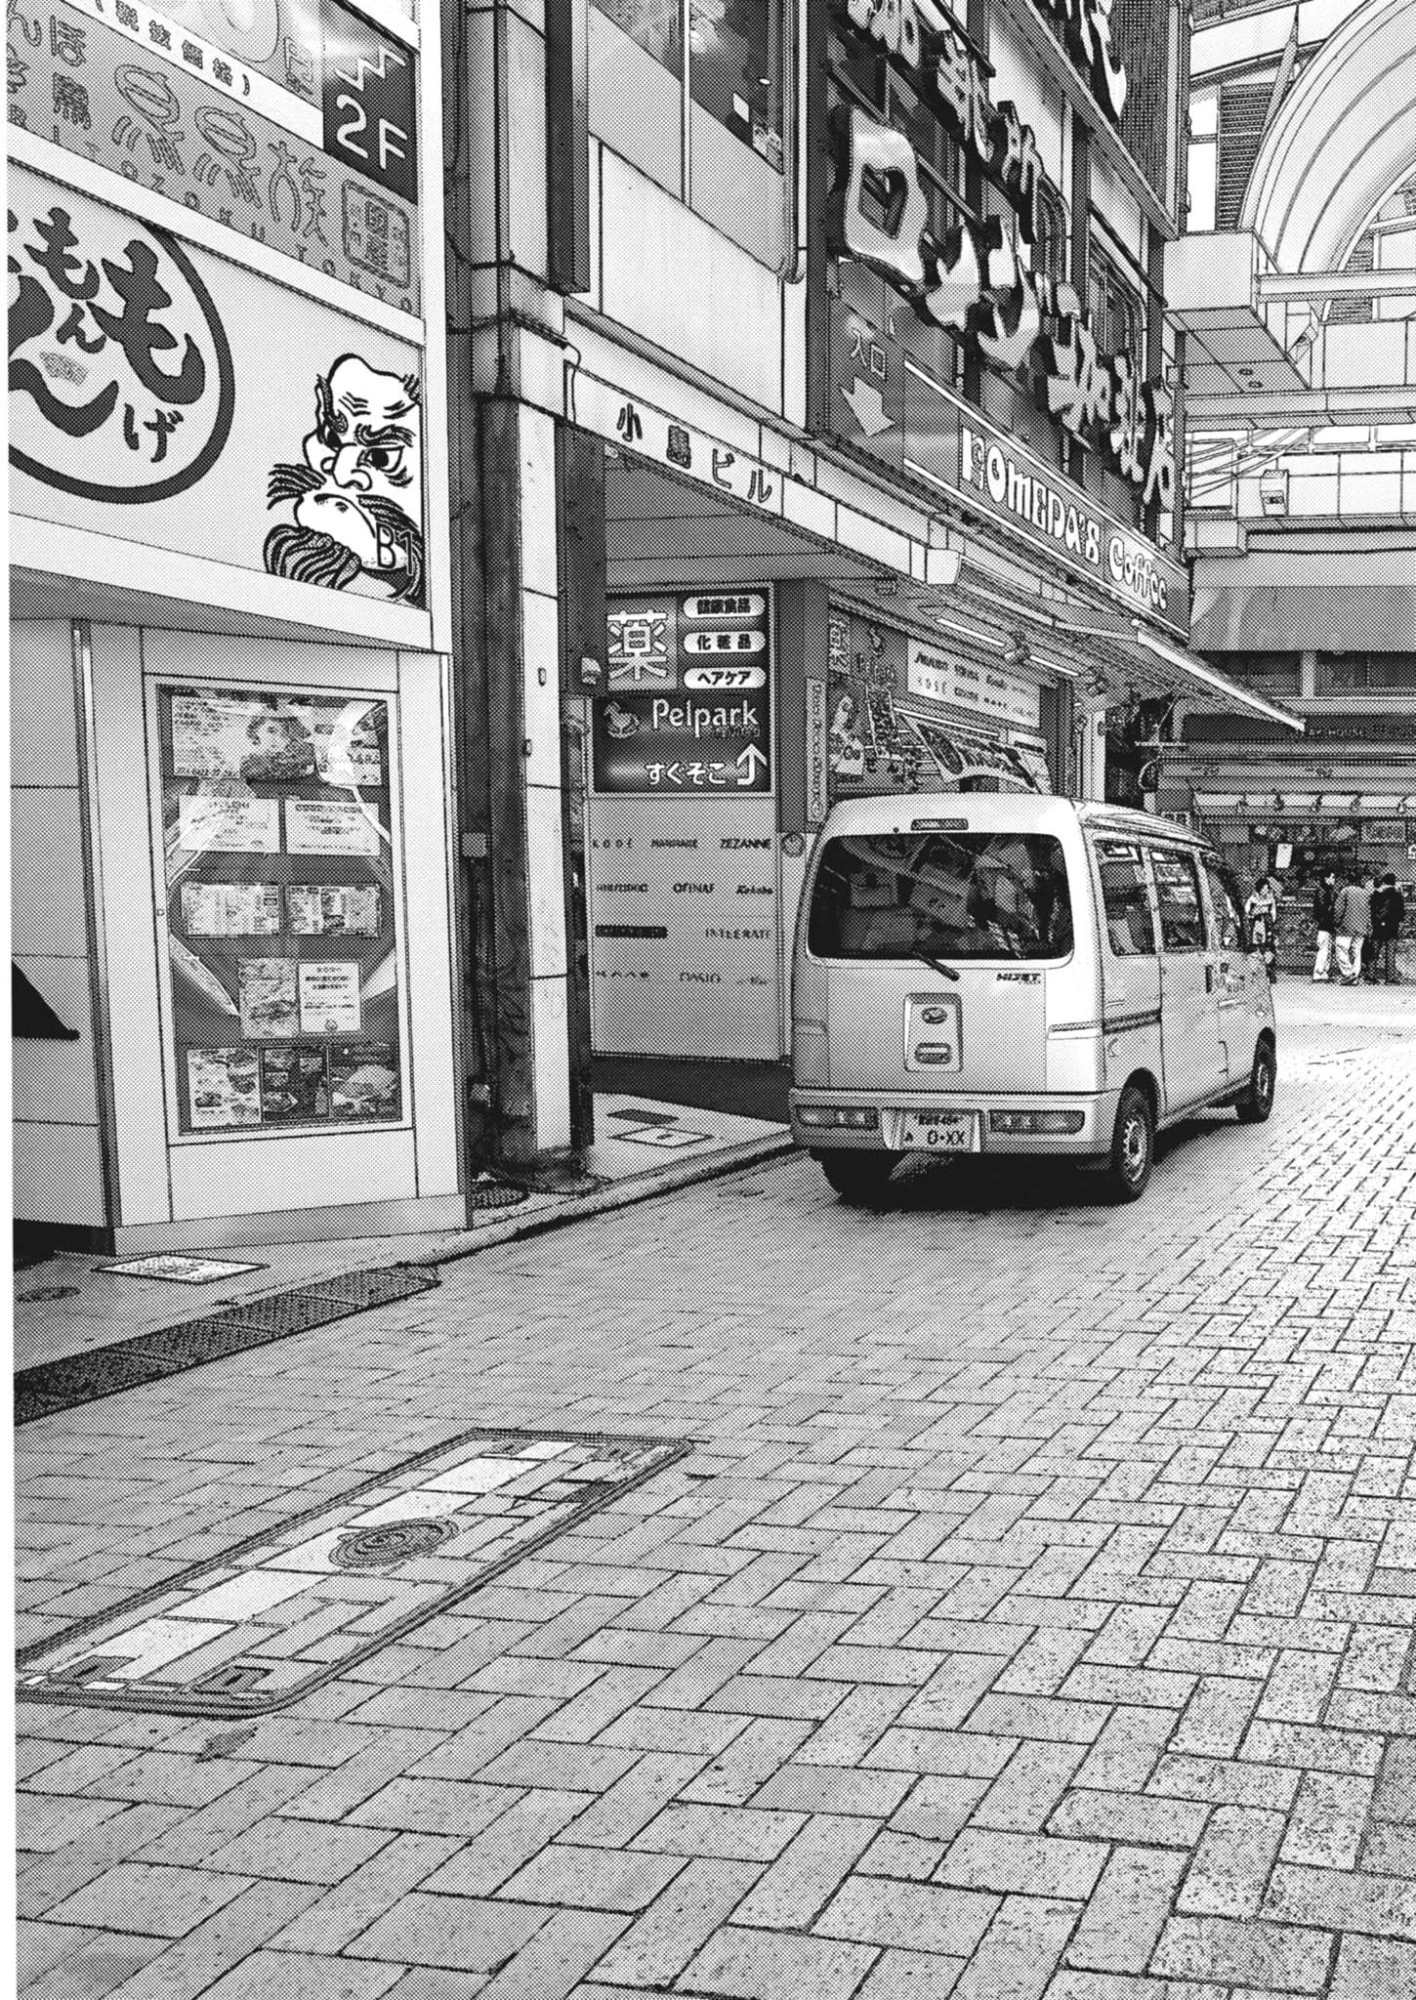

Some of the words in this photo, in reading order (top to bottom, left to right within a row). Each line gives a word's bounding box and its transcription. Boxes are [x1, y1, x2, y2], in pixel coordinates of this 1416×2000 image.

[336, 95, 409, 170] 2F
[607, 610, 667, 680] 薬
[697, 633, 751, 650] 化粧品
[697, 671, 751, 686] ヘアケア
[653, 699, 760, 738] Pelpark
